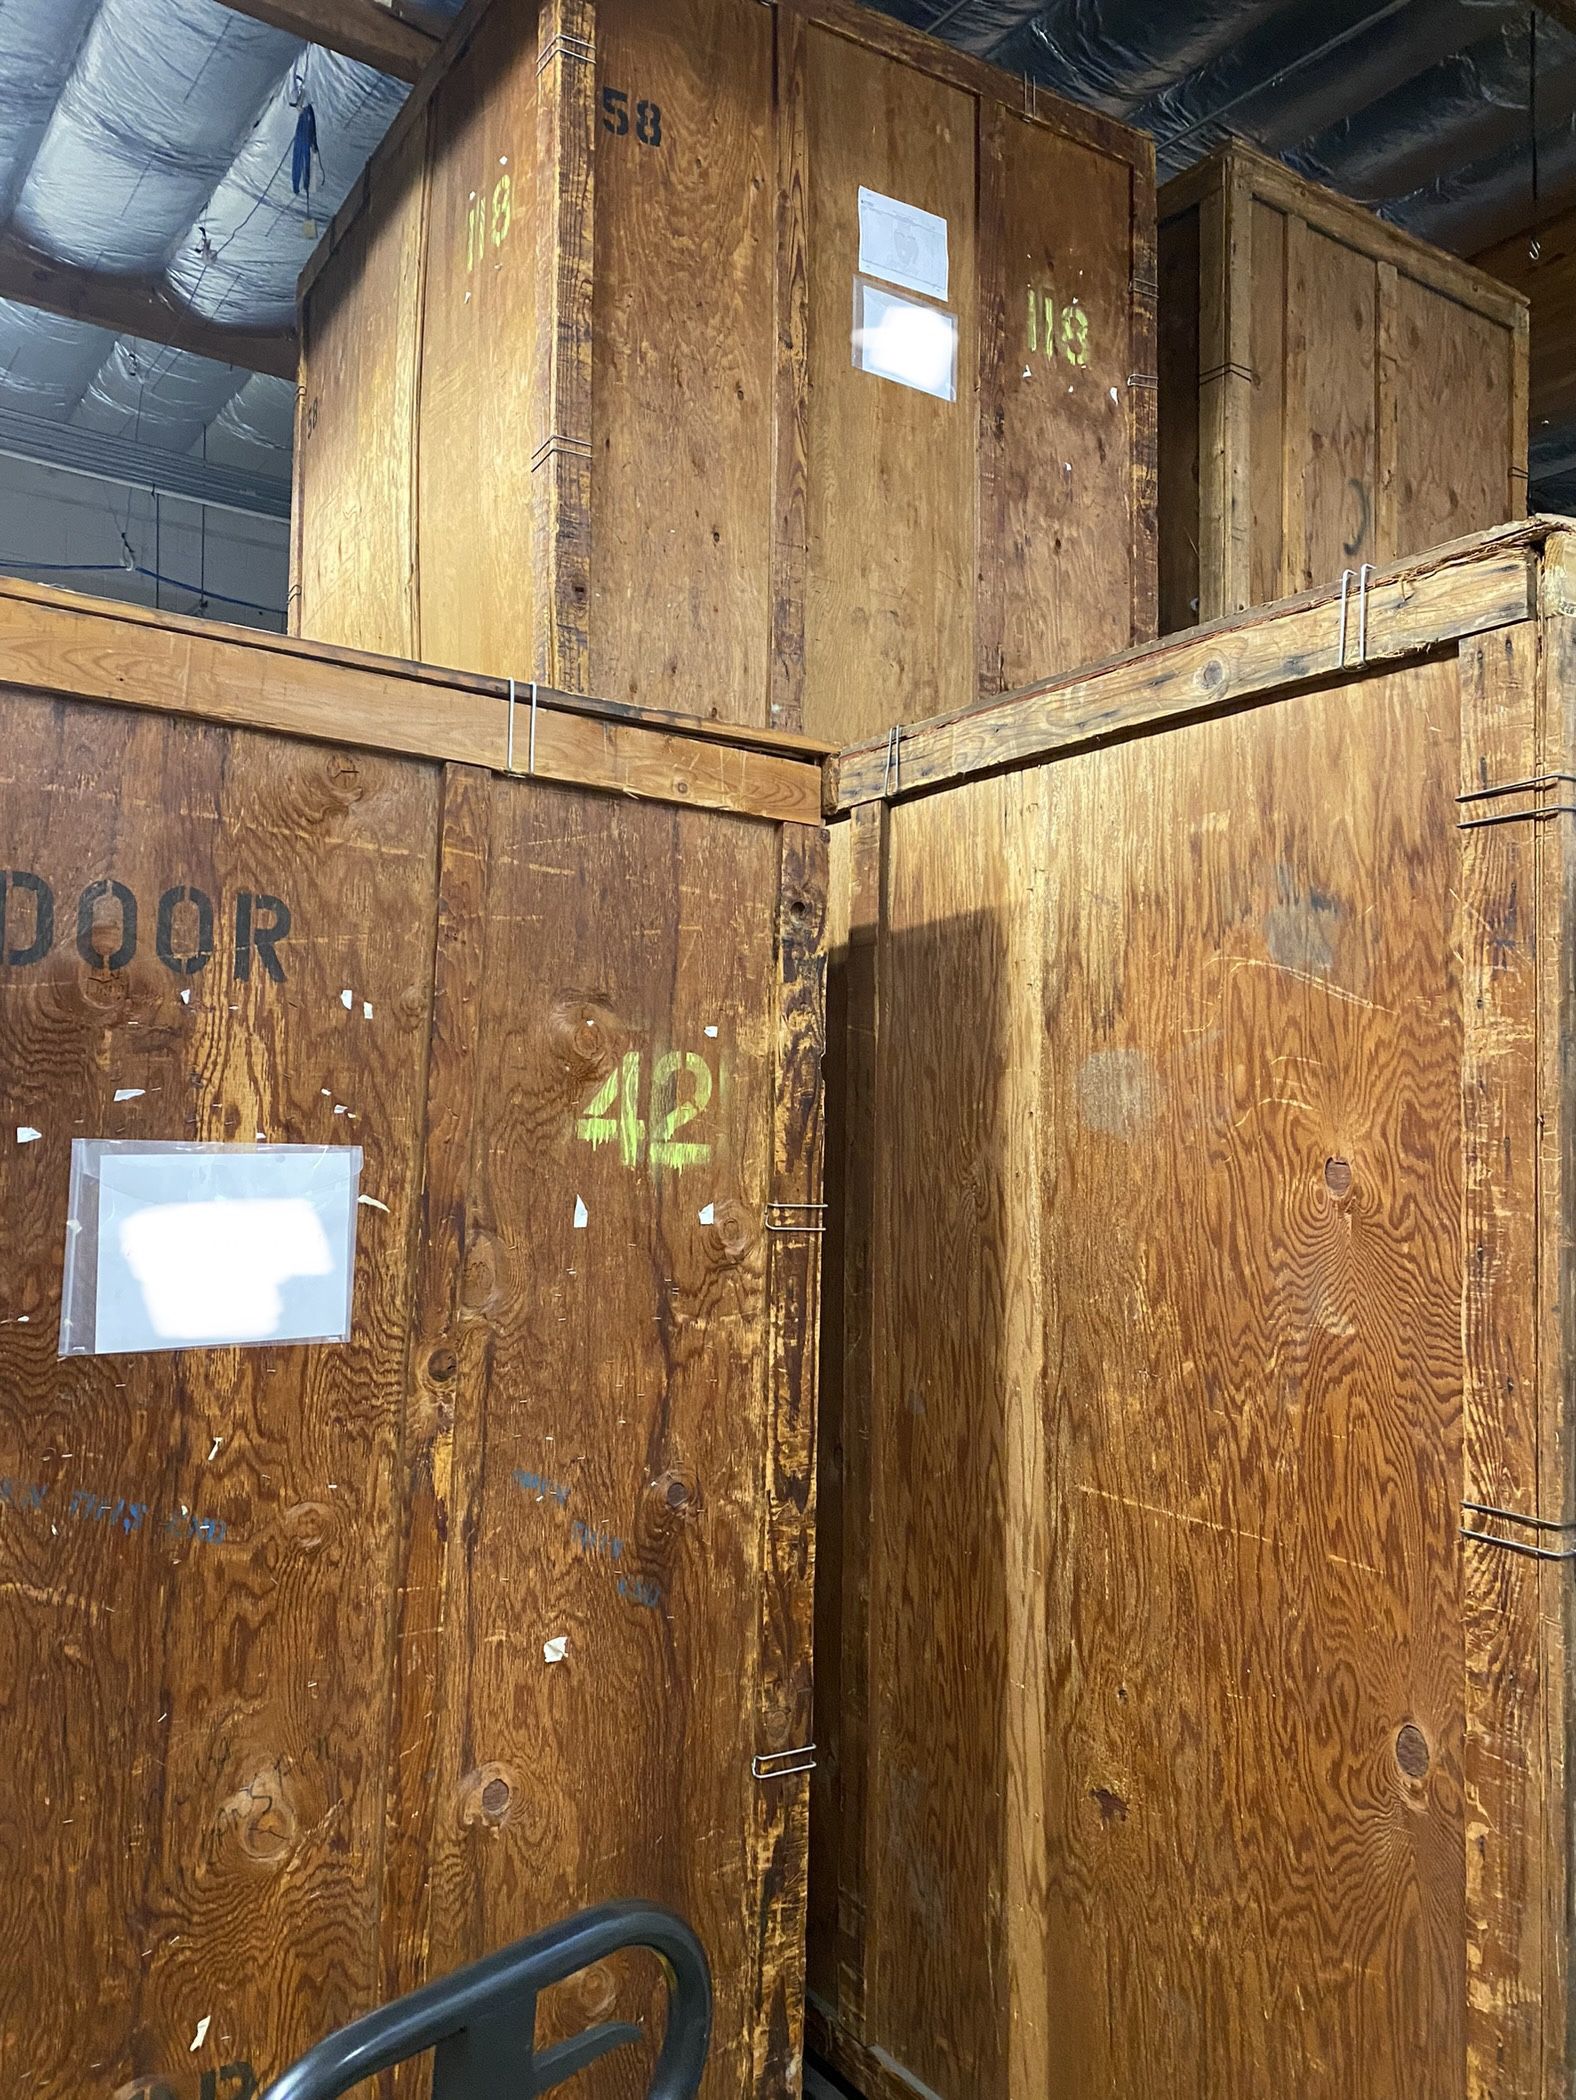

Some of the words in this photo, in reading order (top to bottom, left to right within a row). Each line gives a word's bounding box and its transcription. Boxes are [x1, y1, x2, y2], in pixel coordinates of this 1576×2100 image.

[602, 86, 662, 148] 58
[466, 174, 511, 272] 118
[1027, 289, 1088, 366] 118
[0, 870, 292, 983] DOOR
[576, 1051, 713, 1172] 42
